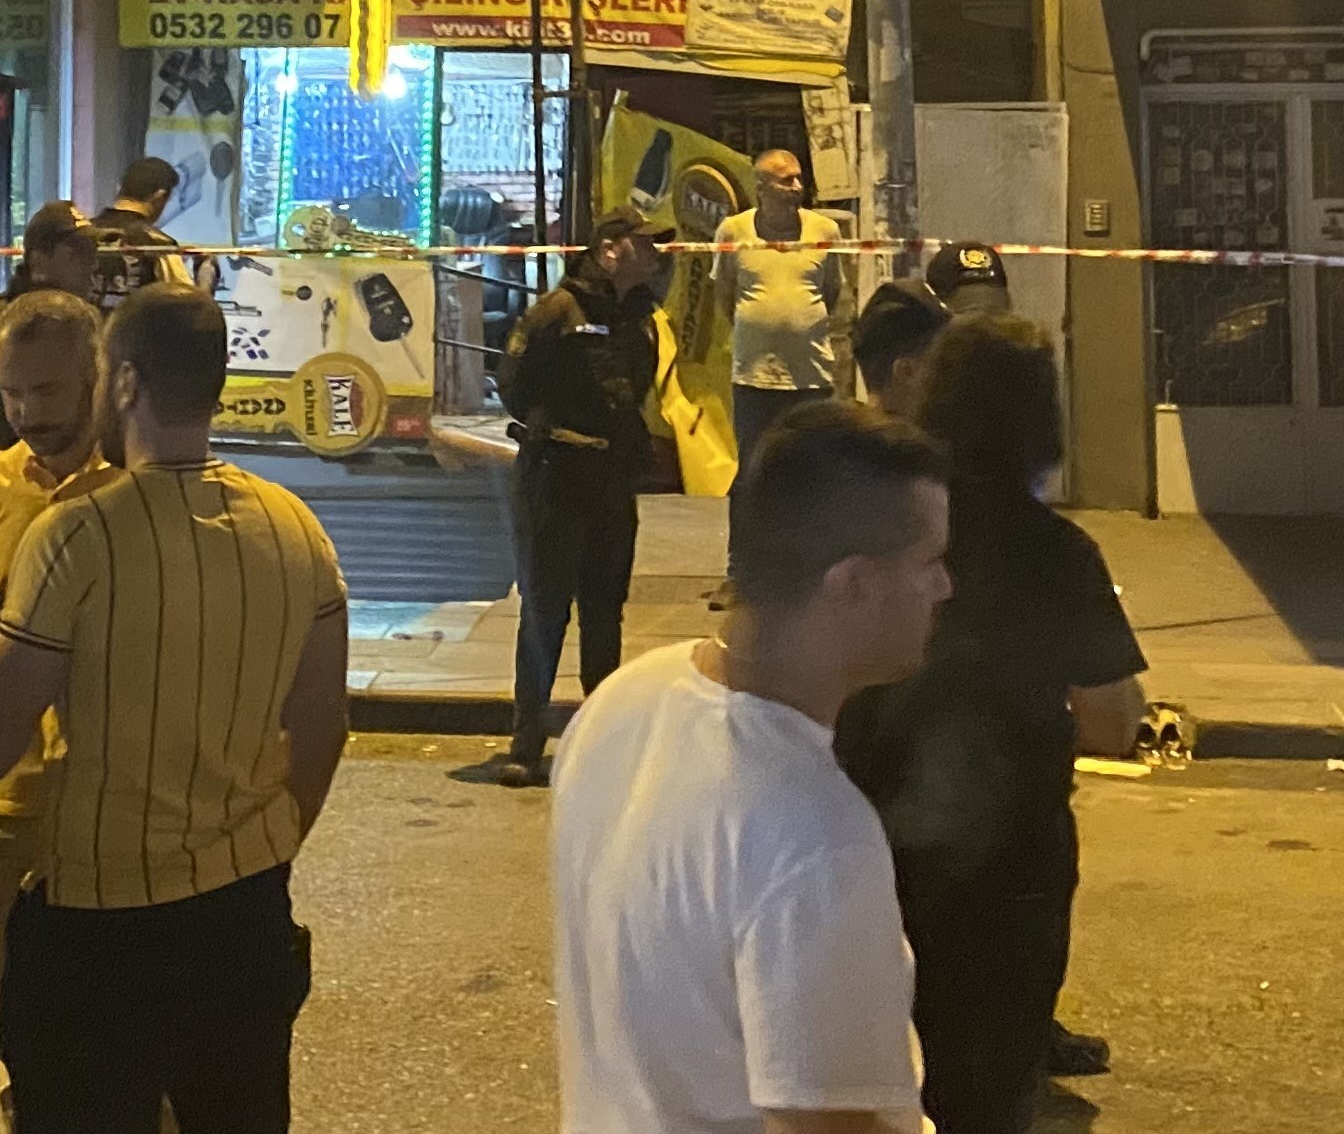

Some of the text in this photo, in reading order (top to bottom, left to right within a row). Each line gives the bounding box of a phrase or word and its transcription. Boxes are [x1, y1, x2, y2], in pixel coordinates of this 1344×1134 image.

[149, 13, 341, 39] 0532 296 07
[328, 378, 356, 434] KALE
